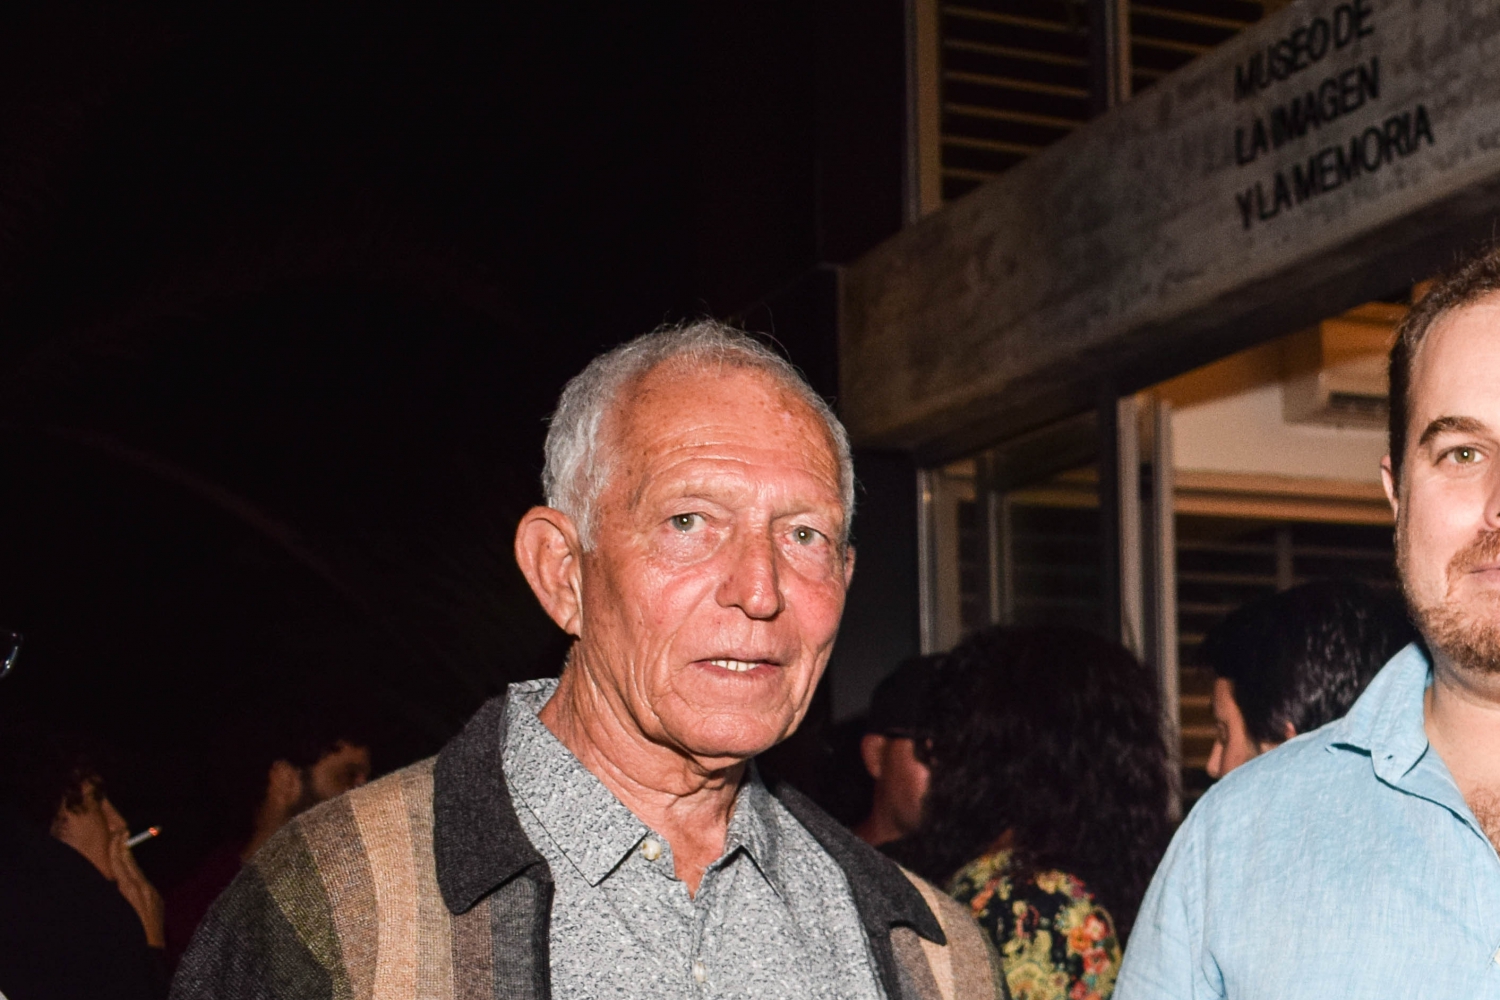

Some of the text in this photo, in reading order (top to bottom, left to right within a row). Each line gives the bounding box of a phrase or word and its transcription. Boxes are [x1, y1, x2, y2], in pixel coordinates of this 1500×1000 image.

[1234, 0, 1374, 99] MUSEO DE
[1235, 55, 1380, 166] LA IMAGEN
[1235, 104, 1435, 230] Y LA MEMORIA
